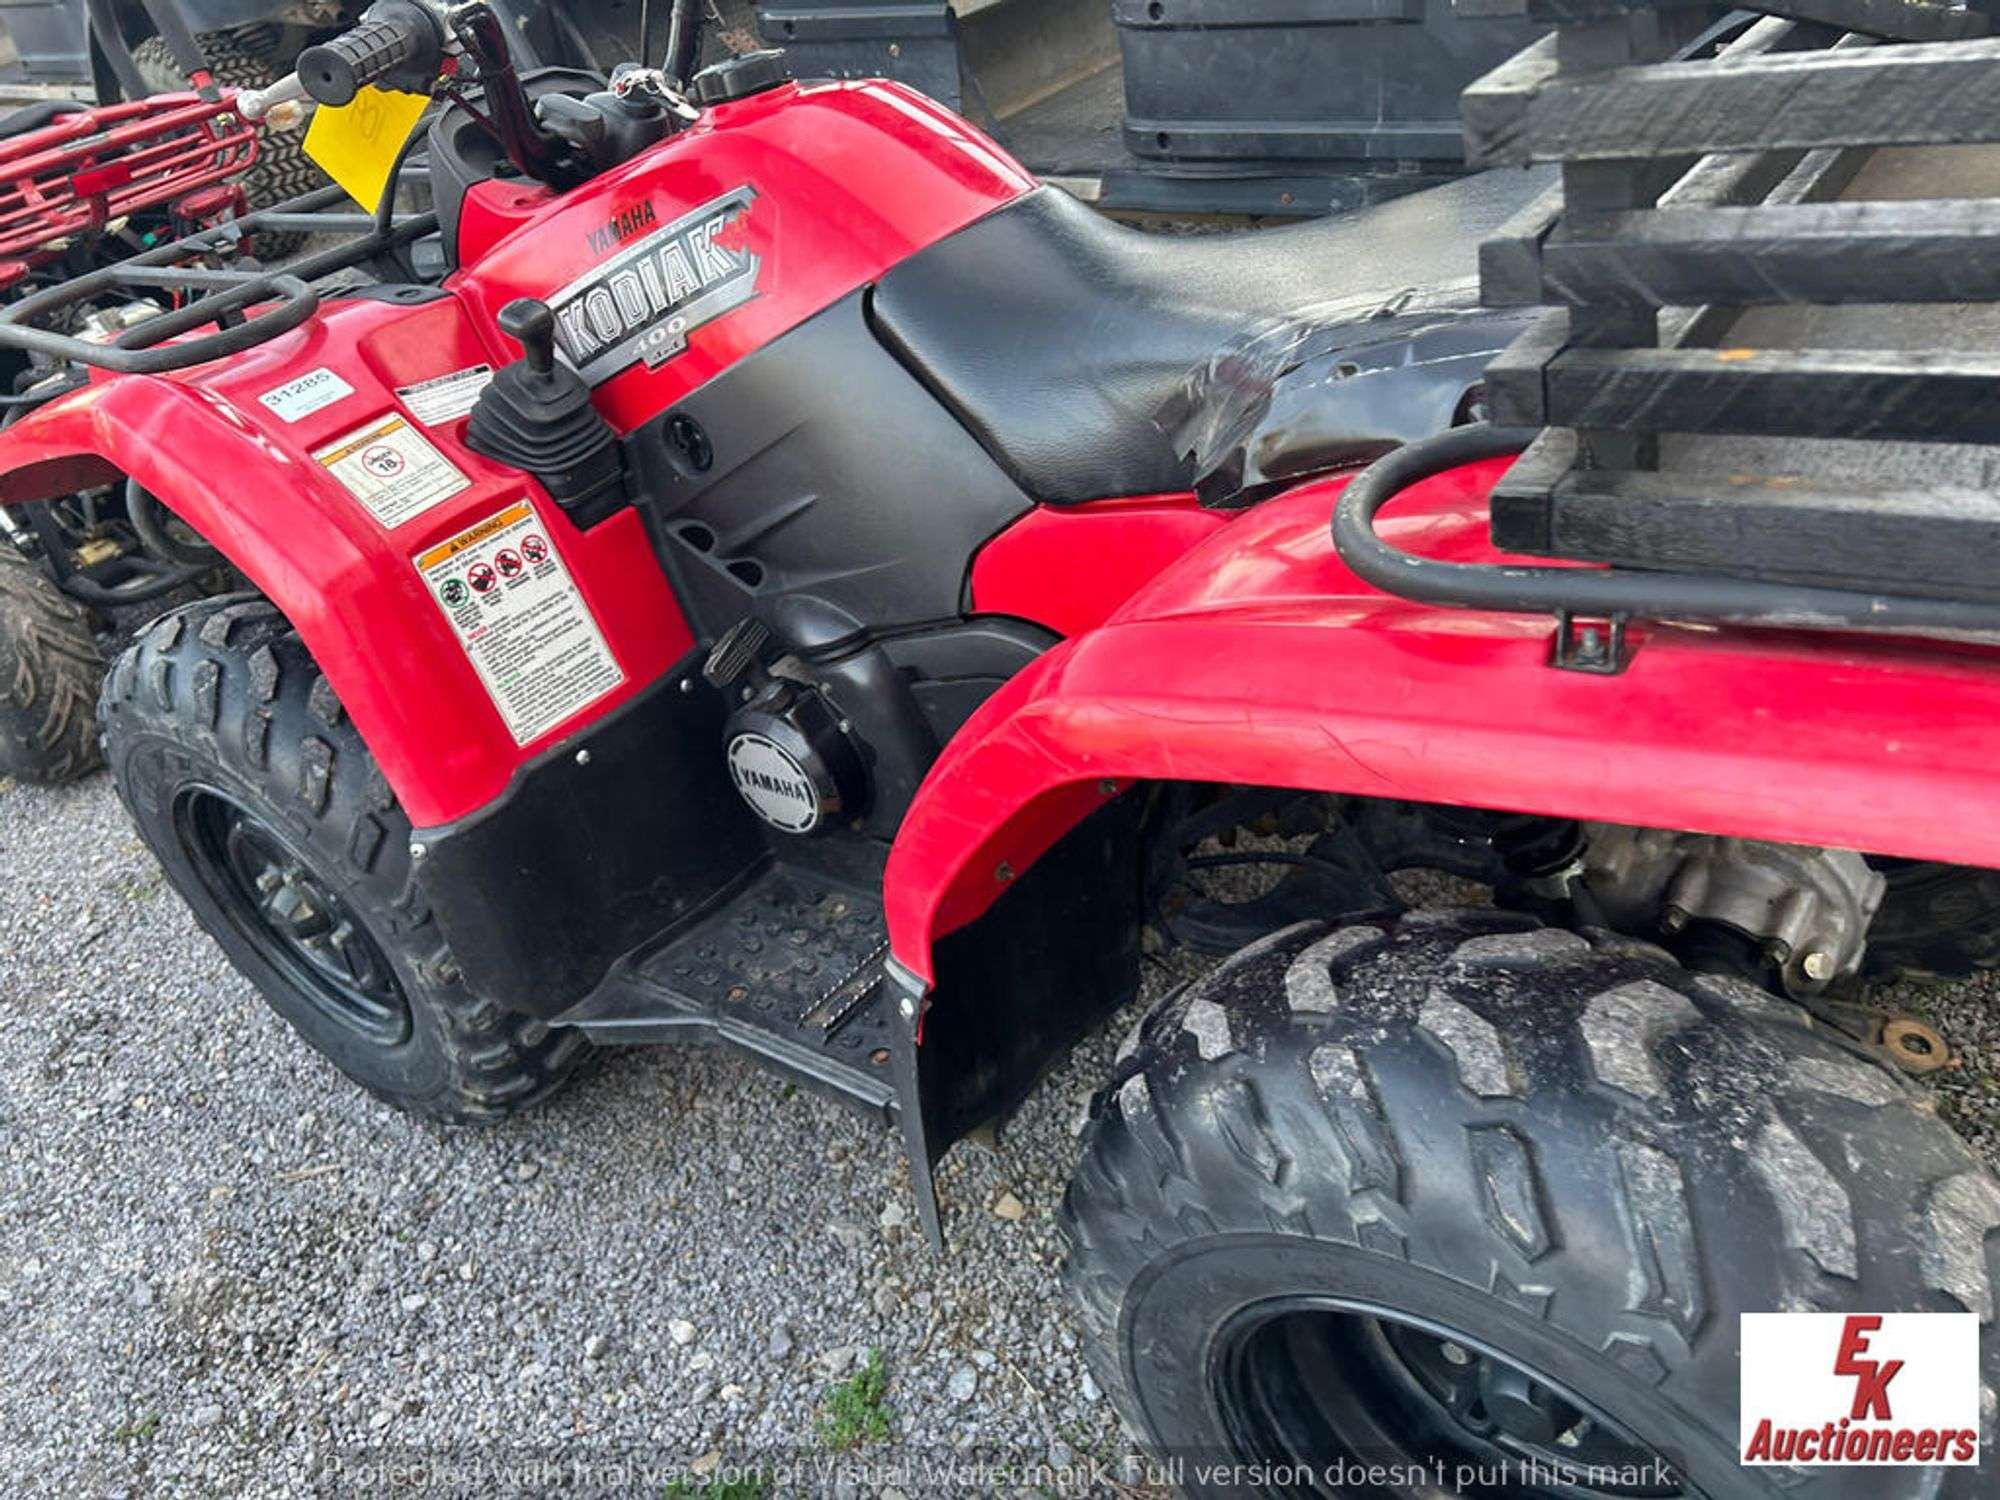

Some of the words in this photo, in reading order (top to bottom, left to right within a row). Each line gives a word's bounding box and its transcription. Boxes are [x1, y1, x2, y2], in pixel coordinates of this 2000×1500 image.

[585, 200, 656, 255] YAMAHA
[556, 216, 738, 363] KODIAK
[265, 371, 330, 406] 31285
[460, 518, 504, 547] WARNING
[740, 766, 806, 802] YAMAHA
